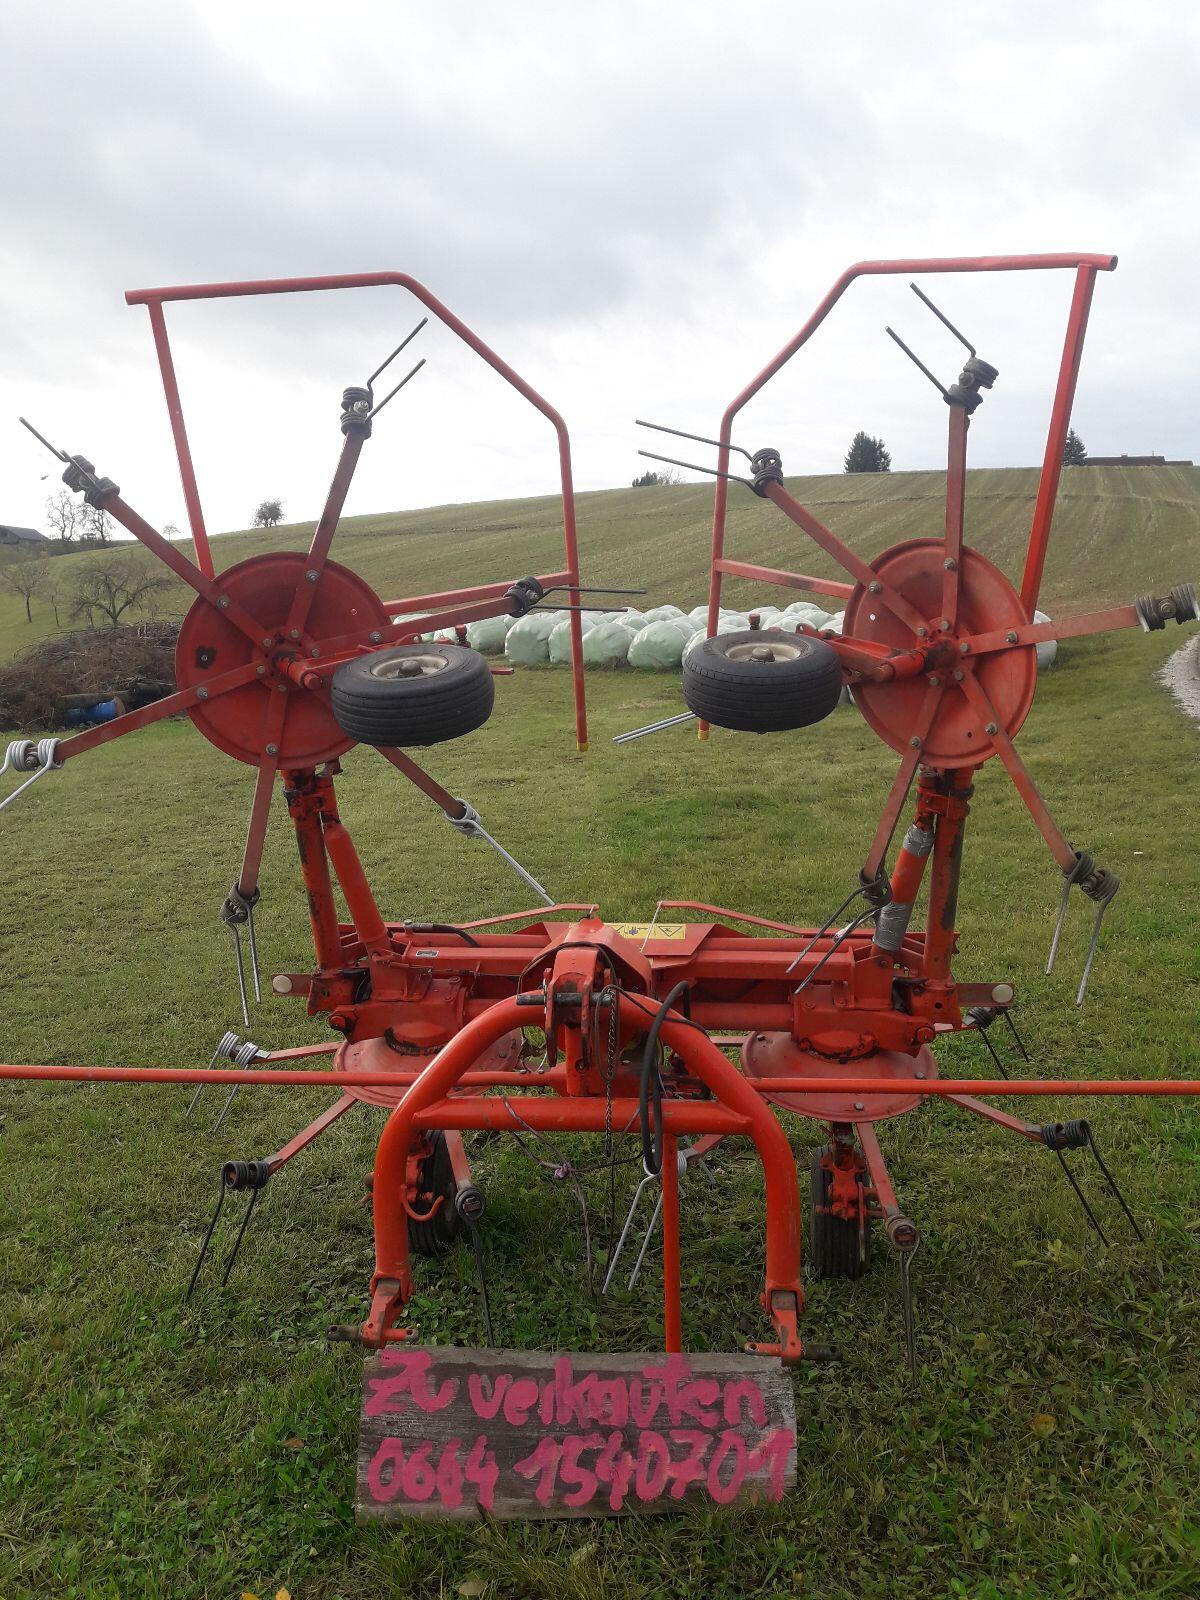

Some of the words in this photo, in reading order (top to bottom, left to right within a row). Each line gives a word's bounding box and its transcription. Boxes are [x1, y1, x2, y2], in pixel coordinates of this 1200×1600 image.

[364, 1350, 458, 1417] Zu
[368, 1435, 500, 1510] 0664
[513, 1429, 795, 1511] 1540701
